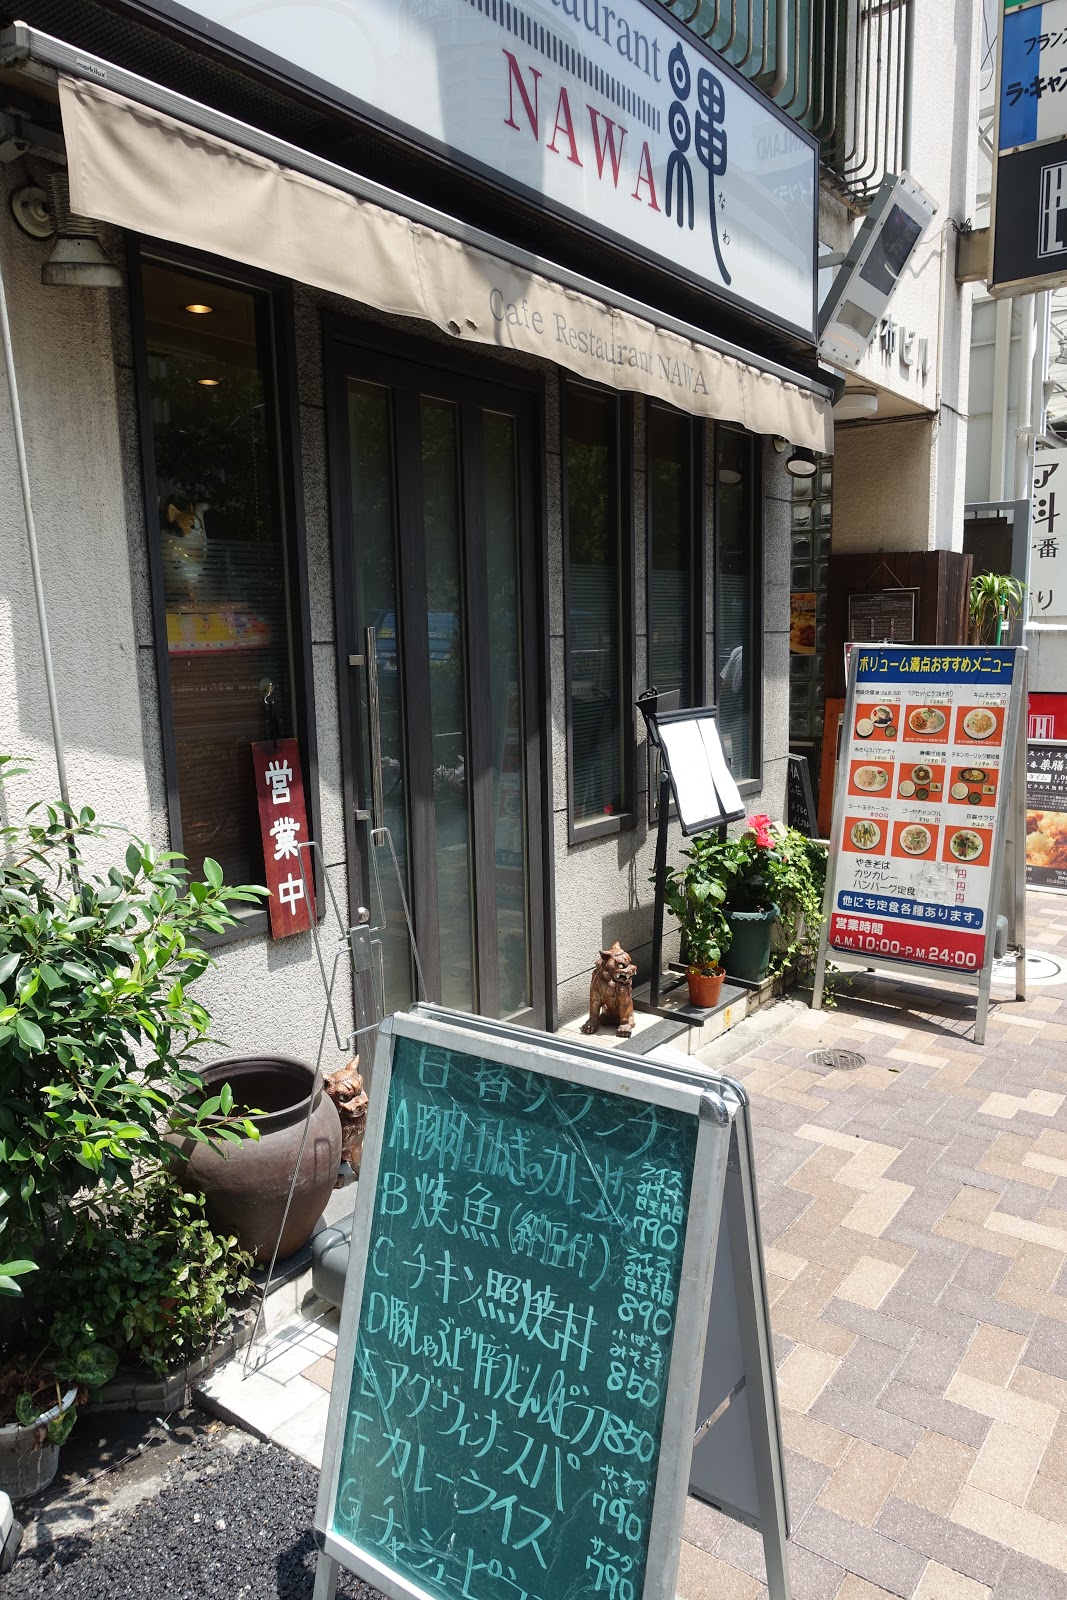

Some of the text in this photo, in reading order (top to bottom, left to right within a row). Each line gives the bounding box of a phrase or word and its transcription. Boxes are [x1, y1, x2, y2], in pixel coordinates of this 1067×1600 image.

[551, 0, 661, 83] aurant
[77, 61, 106, 79] markilux
[502, 48, 661, 212] NAWA
[489, 288, 709, 396] Cafe Restaurant NAWA
[858, 656, 1013, 673] ボリューム満点おすすめメニュー
[1028, 750, 1067, 760] スパイス
[265, 759, 304, 916] 営業中
[854, 869, 898, 881] カツカレー
[856, 858, 891, 870] やきそば
[957, 869, 967, 879] 円
[853, 880, 916, 896] ハンバーグ定食
[955, 893, 965, 903] 円
[956, 881, 966, 891] 円
[835, 917, 884, 936] 営業時間
[842, 895, 980, 926] 他にも定食各種あります。
[380, 1172, 408, 1215] B
[634, 1215, 678, 1250] 790
[373, 1236, 395, 1277] C
[617, 1293, 672, 1336] 890
[606, 1361, 659, 1407] 850
[602, 1413, 655, 1463] 850
[376, 1428, 552, 1570] カレーライス
[592, 1492, 642, 1541] 790
